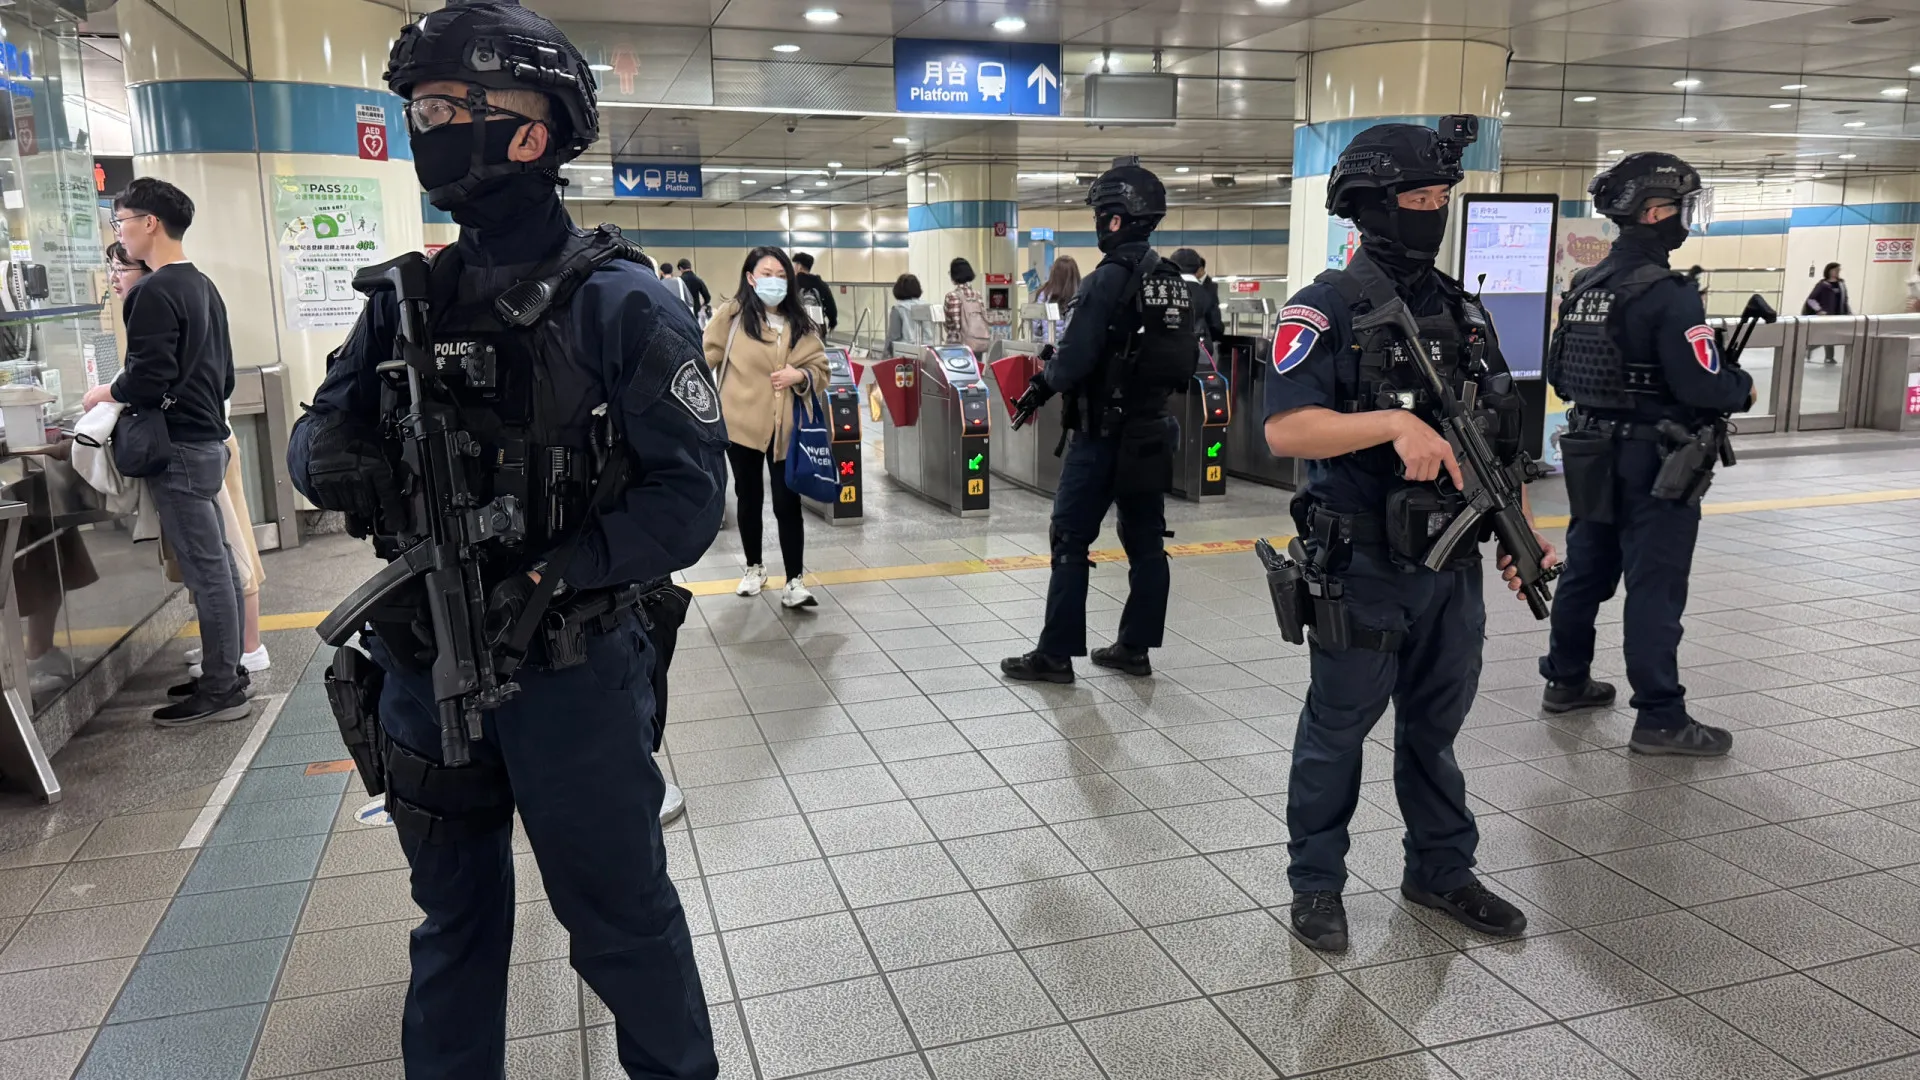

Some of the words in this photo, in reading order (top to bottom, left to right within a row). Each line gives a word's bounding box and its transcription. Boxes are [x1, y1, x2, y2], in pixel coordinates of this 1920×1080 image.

[923, 61, 967, 85] 月台
[910, 87, 968, 102] Platform
[365, 126, 380, 135] AED
[665, 170, 689, 183] 月台
[301, 184, 341, 193] TPASS
[343, 184, 358, 193] 2.0
[665, 184, 696, 192] Platform
